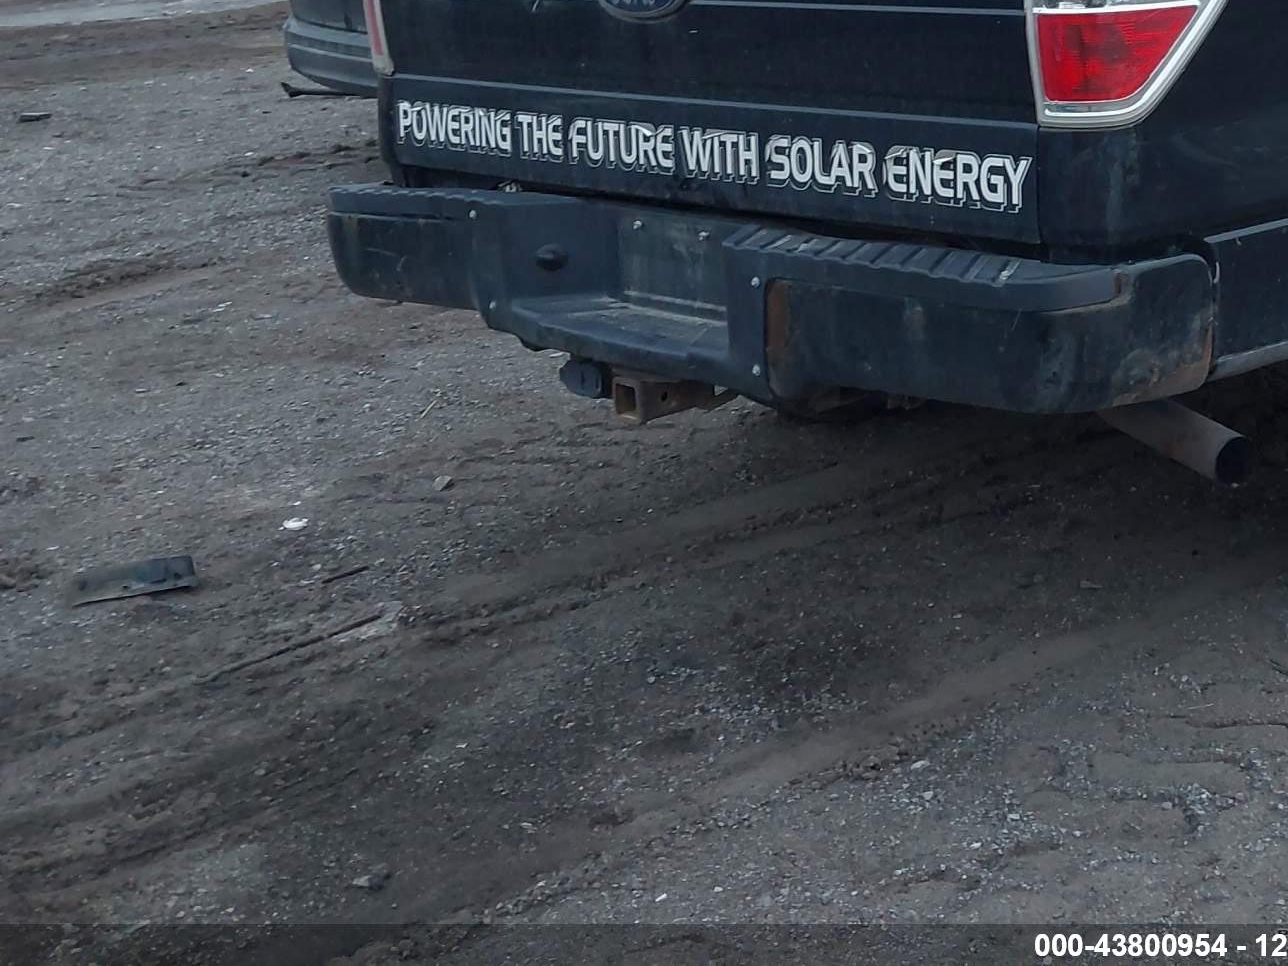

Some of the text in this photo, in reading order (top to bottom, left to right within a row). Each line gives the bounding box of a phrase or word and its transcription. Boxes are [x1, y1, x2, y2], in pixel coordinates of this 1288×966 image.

[397, 100, 1032, 213] POWERING THE FUTURE WITH SOLAR ENERGY
